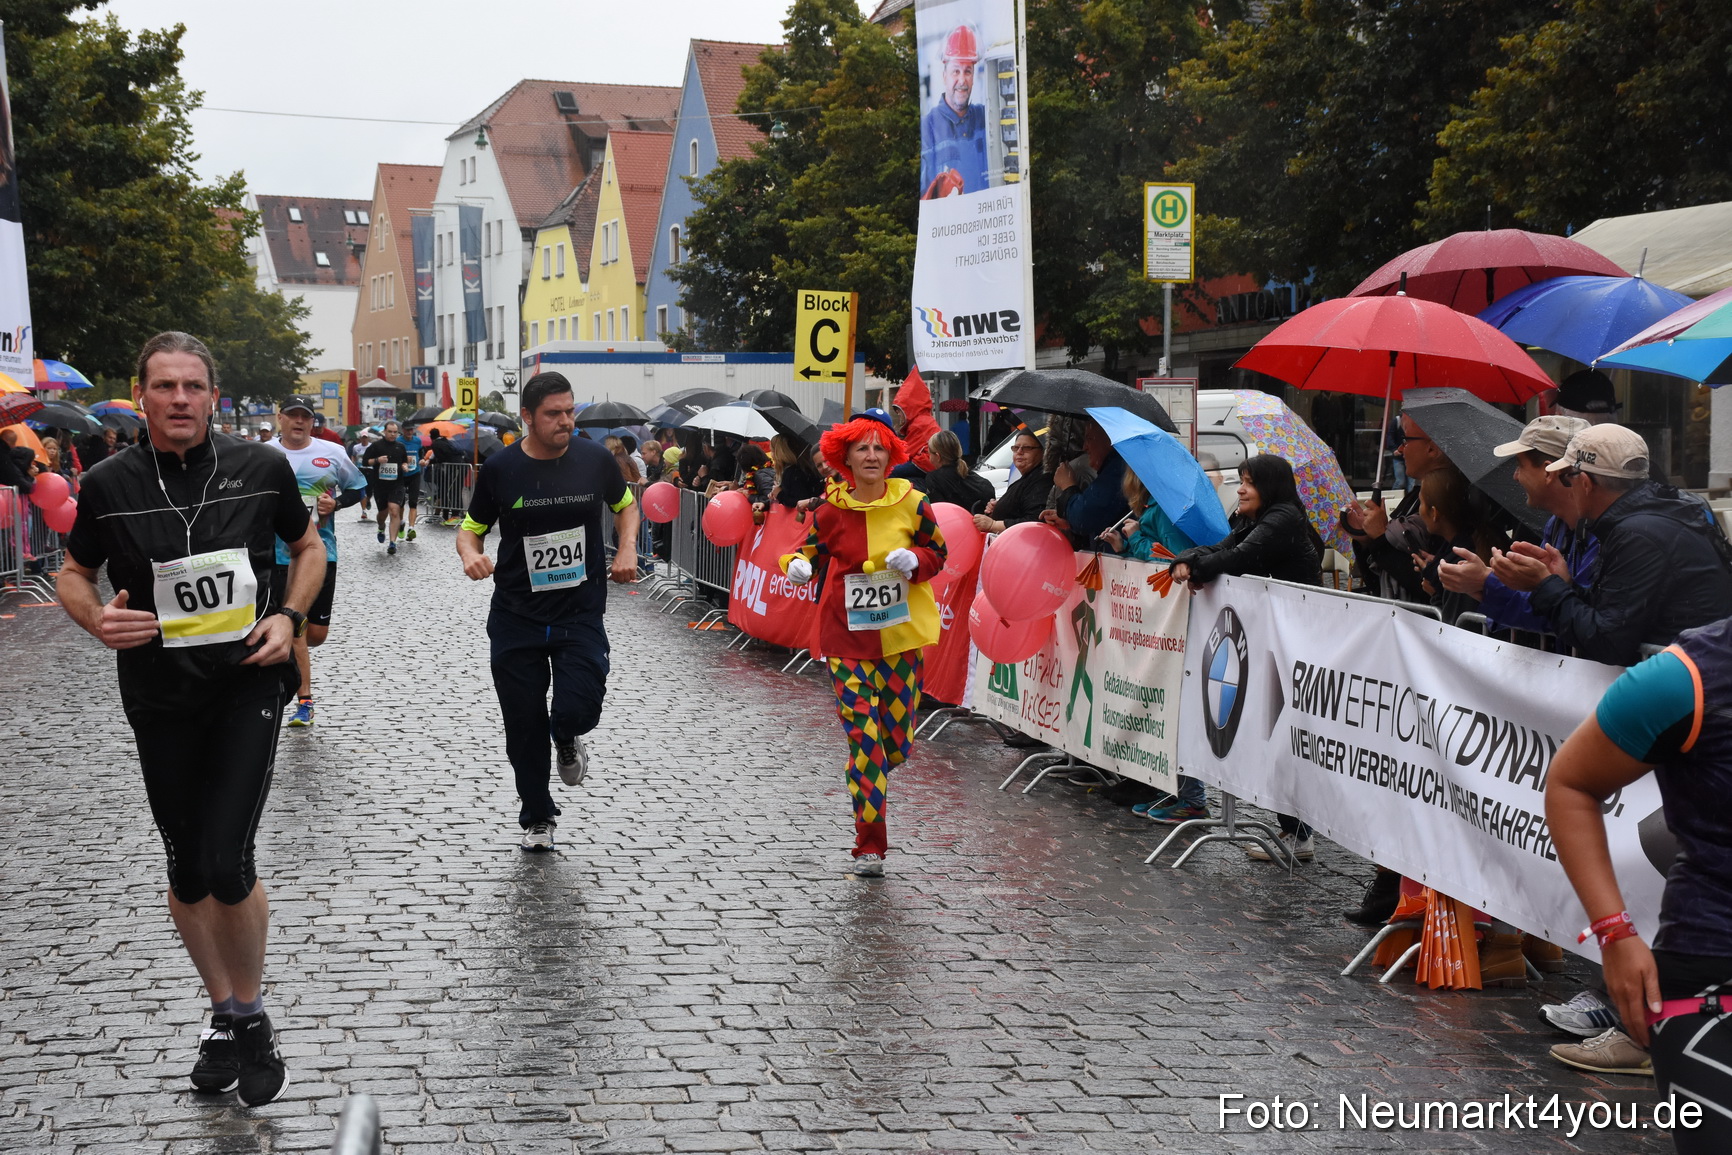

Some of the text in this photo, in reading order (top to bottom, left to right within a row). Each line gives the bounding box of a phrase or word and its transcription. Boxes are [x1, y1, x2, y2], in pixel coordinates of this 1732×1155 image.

[550, 296, 566, 312] HOTEL
[804, 294, 850, 312] Block
[810, 318, 841, 363] C
[459, 378, 477, 386] Block
[462, 388, 473, 406] D
[523, 493, 595, 508] GOSSEN METRAWATT
[191, 552, 242, 571] BOCK
[532, 541, 583, 571] 2294
[547, 571, 577, 582] Roman
[174, 570, 235, 613] 607
[851, 583, 902, 609] 2261
[1208, 610, 1248, 662] BMW
[1292, 660, 1346, 722] BMW
[1102, 702, 1165, 740] Hausmeisterdienst
[1290, 725, 1347, 775] WENIGER
[1349, 744, 1448, 810] VERBRAUCH.
